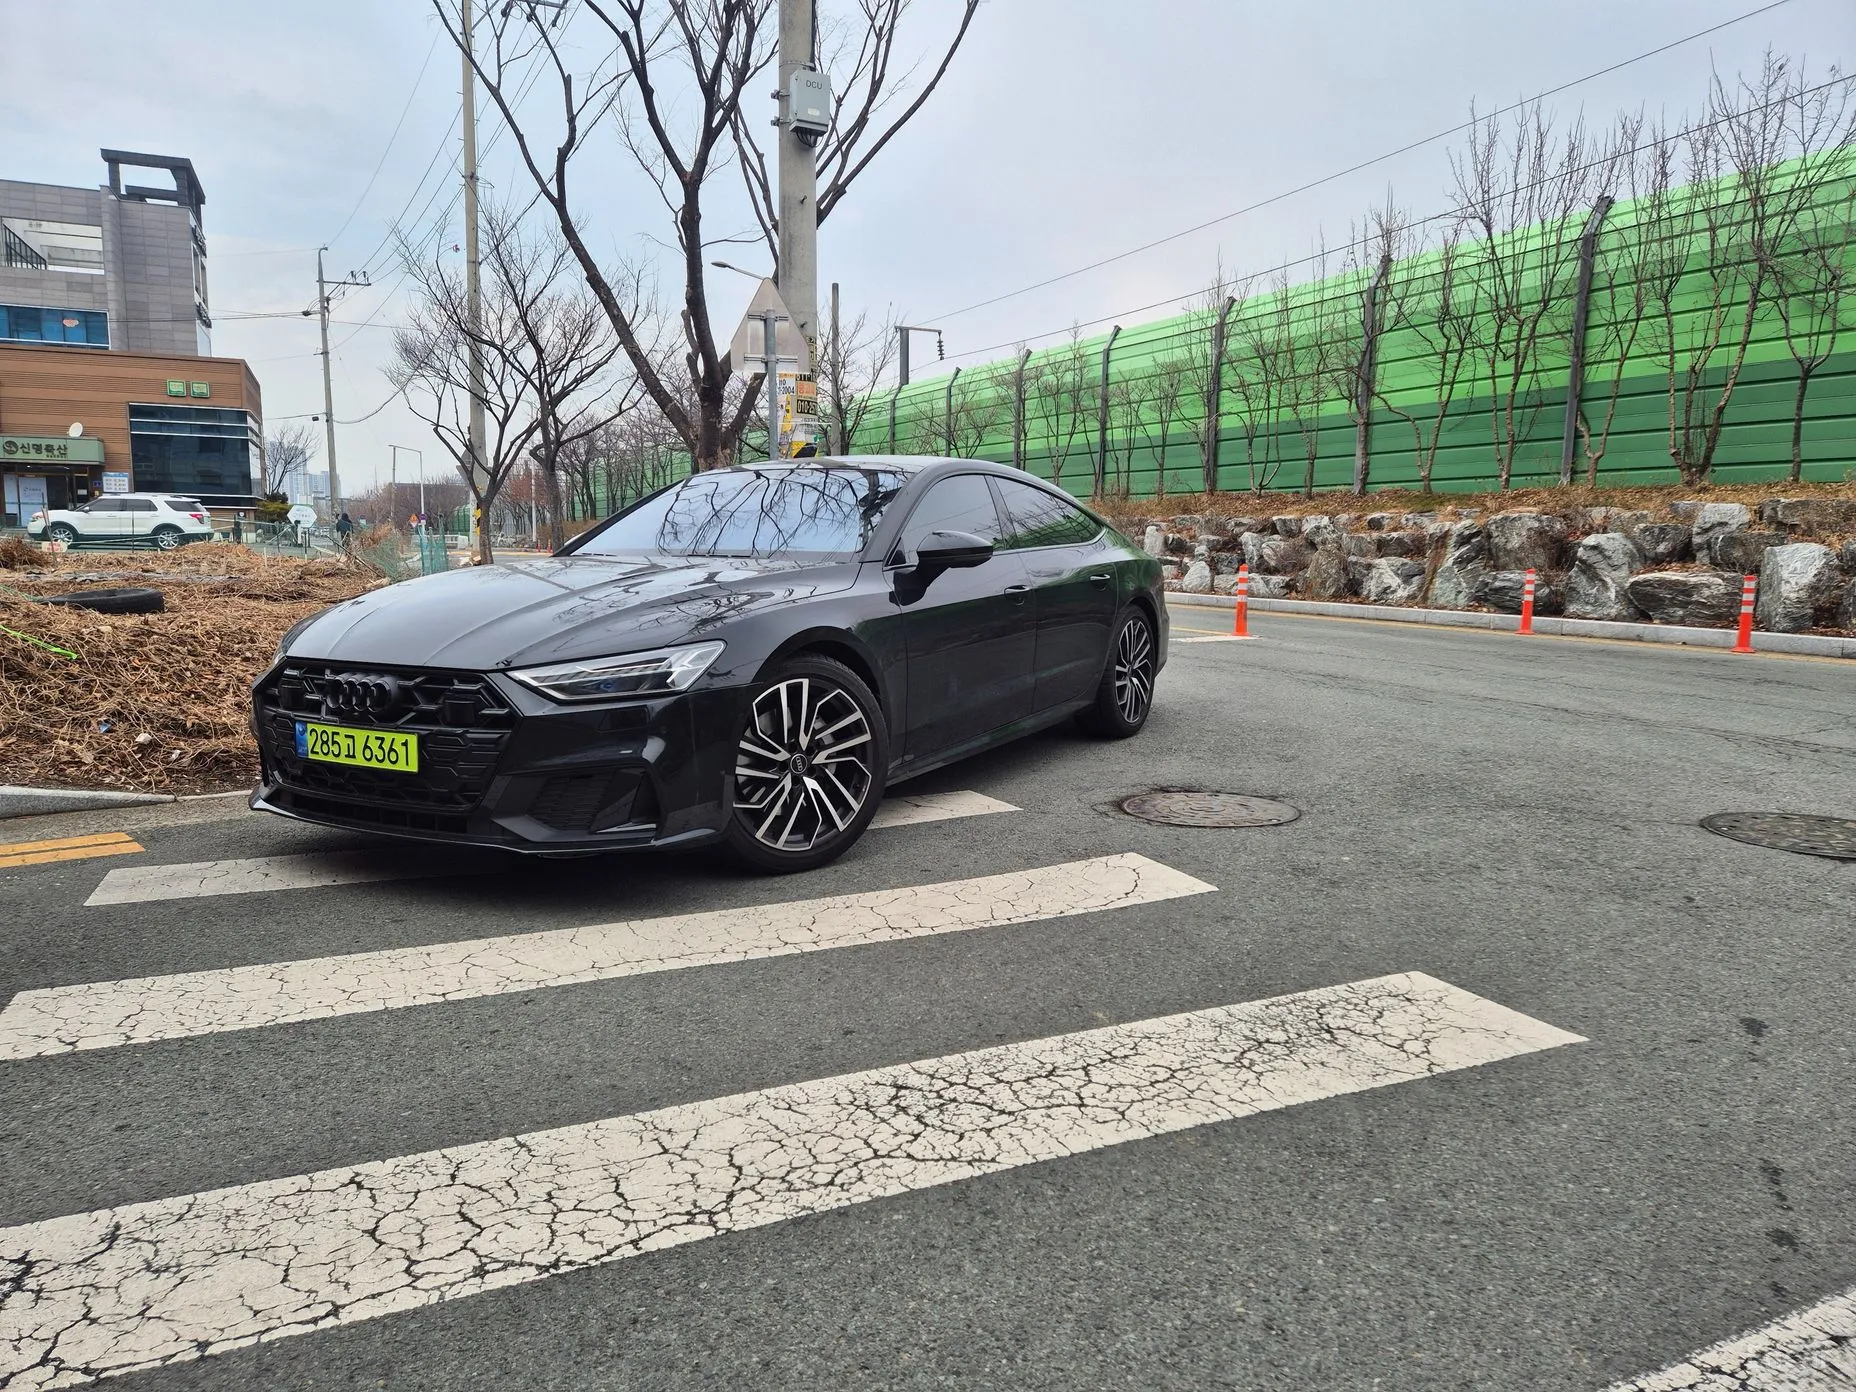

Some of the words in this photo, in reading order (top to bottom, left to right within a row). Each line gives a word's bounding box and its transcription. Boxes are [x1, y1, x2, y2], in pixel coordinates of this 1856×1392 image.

[806, 80, 822, 89] DCU
[309, 728, 356, 759] 285고
[362, 735, 409, 766] 6361
